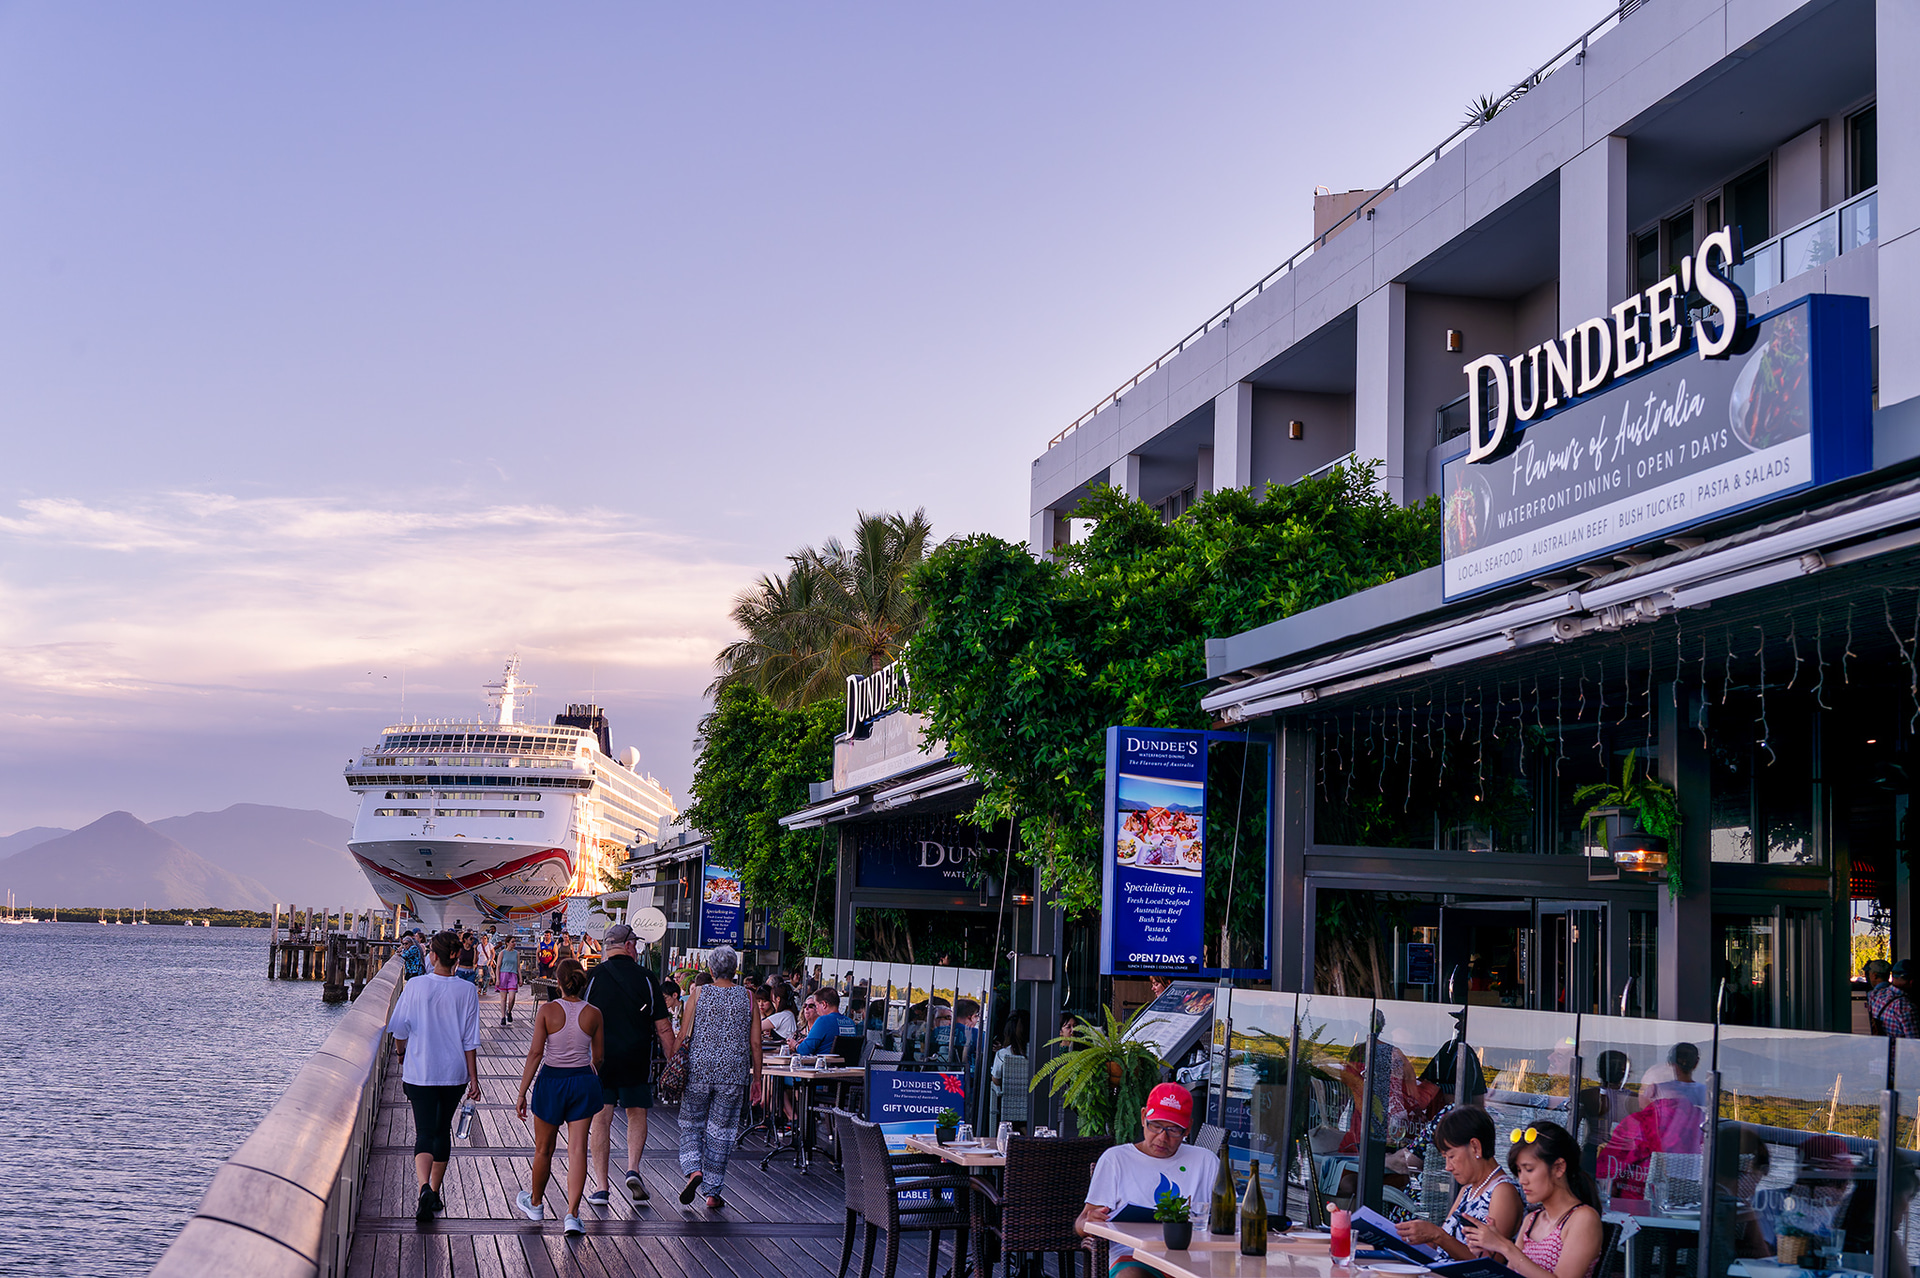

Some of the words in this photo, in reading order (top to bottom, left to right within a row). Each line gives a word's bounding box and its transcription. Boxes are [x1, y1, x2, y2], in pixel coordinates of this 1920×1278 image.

[1463, 225, 1737, 465] DUNDEE'S
[1512, 438, 1583, 496] Flavours
[1589, 415, 1608, 471] of
[1611, 378, 1705, 463] Australia
[1497, 487, 1571, 529] WATERFRONT
[1574, 469, 1621, 502] DINING
[1636, 448, 1674, 478] OPEN
[1679, 444, 1686, 464] 7
[1691, 428, 1728, 460] DAYS
[1458, 561, 1484, 581] LOCAL
[1484, 547, 1524, 573] SEAFOOD
[1531, 526, 1584, 557] AUSTRALIAN
[1586, 518, 1608, 539] BEEF
[1618, 505, 1644, 528] BUSH
[1647, 491, 1686, 520] TUCKER
[1698, 477, 1730, 502] PASTA
[1733, 473, 1742, 490] &
[1745, 456, 1791, 487] SALADS
[1126, 737, 1198, 755] DUNDEE'S
[497, 885, 553, 897] NORWEGIAN
[1124, 881, 1176, 895] Specialising
[1145, 897, 1164, 905] Local
[1164, 898, 1191, 907] Seafood
[1167, 907, 1183, 916] Beef
[633, 917, 665, 928] Ollie's
[1138, 915, 1155, 923] Bush
[1156, 916, 1178, 924] Tucker
[1144, 925, 1164, 933] Pastas
[1146, 934, 1168, 942] Salads
[1128, 953, 1154, 963] OPEN
[1154, 953, 1161, 963] 7
[1162, 954, 1185, 964] DAYS
[892, 1078, 941, 1091] DUNDEE'S
[882, 1104, 902, 1112] GIFT
